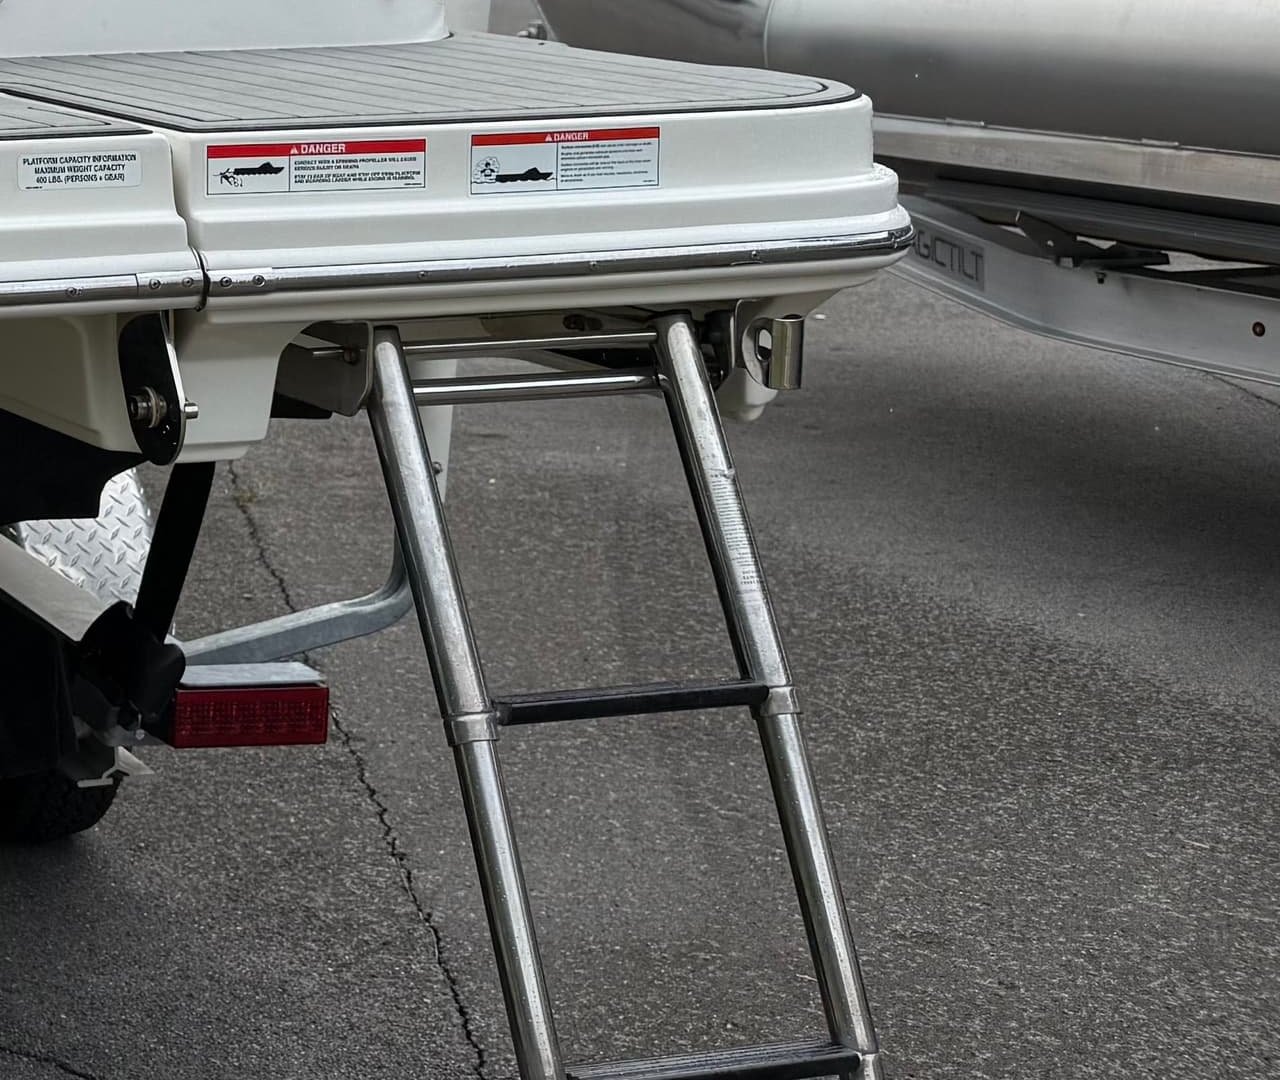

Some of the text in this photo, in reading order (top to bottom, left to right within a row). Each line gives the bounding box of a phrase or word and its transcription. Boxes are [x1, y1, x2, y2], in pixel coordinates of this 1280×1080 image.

[553, 131, 589, 142] DANGER
[301, 143, 346, 154] DANGER
[22, 154, 137, 165] PLATFORM CAPACITY INFORMATION
[34, 163, 126, 174] MAXIMUM WEIGHT CAPACITY
